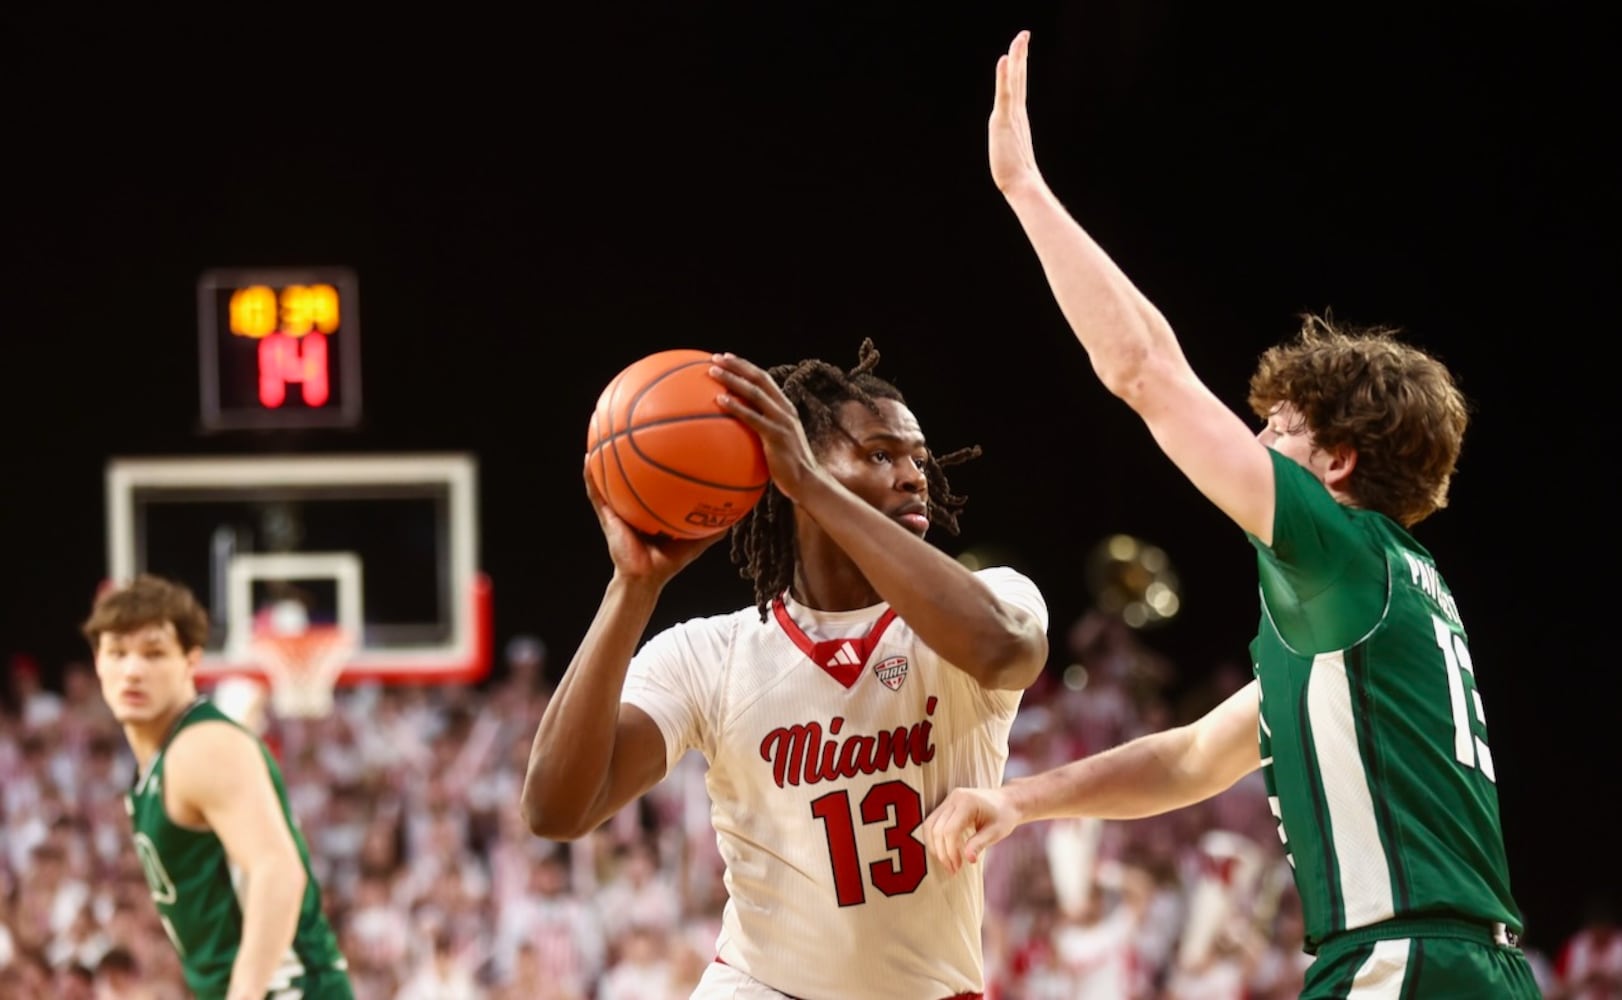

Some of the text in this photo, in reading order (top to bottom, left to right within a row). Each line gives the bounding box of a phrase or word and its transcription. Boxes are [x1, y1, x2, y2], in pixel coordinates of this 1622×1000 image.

[257, 331, 328, 408] 14
[760, 695, 938, 789] Miami
[810, 779, 928, 908] 13
